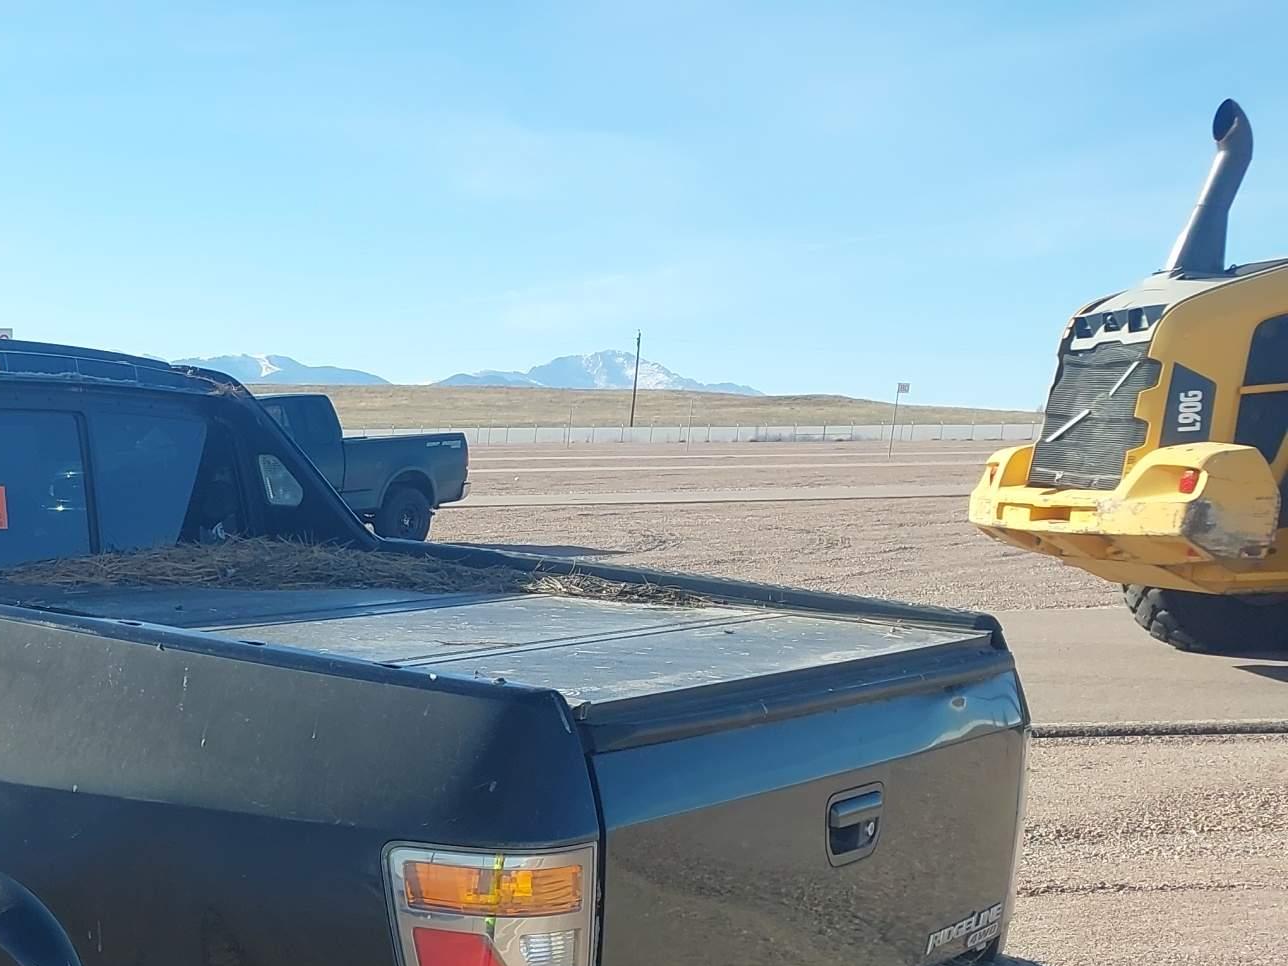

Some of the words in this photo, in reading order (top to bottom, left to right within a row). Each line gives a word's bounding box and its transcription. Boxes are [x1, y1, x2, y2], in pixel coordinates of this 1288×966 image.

[1177, 390, 1202, 432] L90G
[926, 903, 1002, 955] RIDGELINE
[968, 923, 999, 947] 4WD
